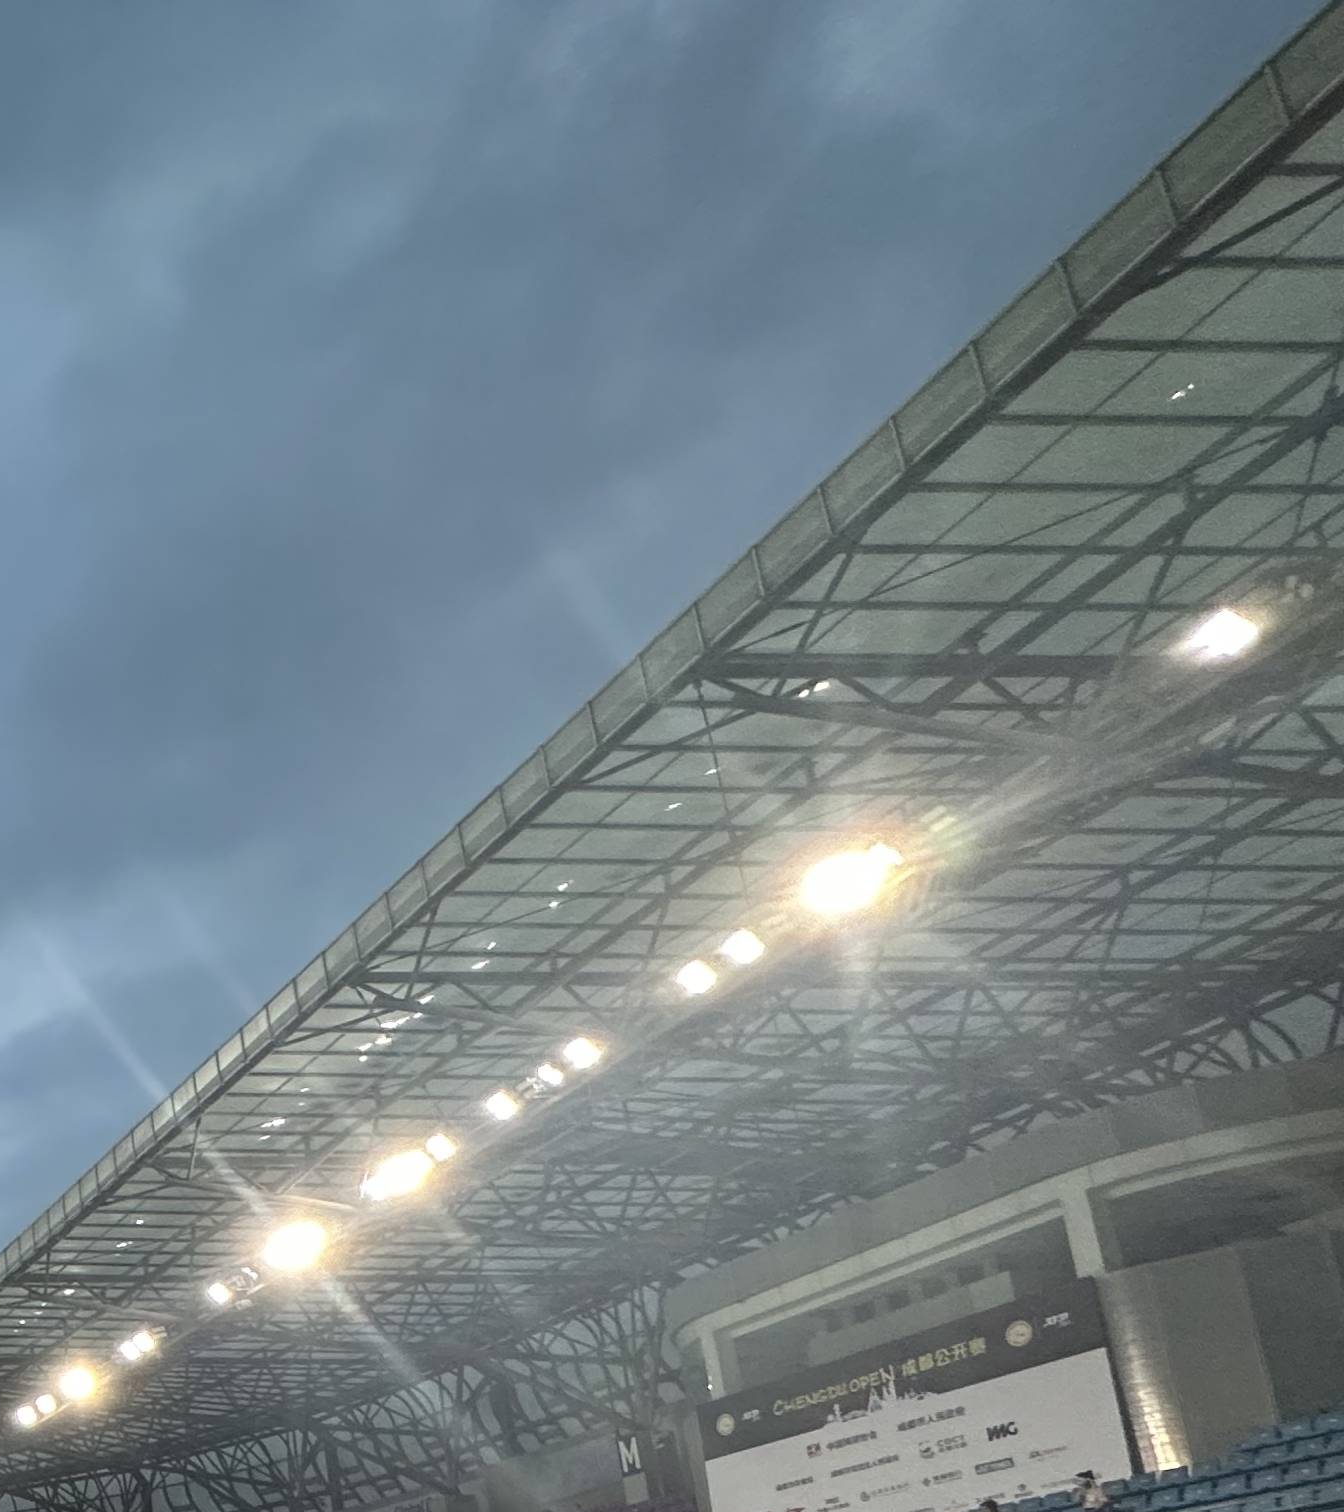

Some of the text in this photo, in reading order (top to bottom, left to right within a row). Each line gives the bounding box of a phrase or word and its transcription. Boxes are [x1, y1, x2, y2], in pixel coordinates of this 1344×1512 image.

[772, 1382, 848, 1416] CHENGDU
[848, 1364, 896, 1394] OPEN
[618, 1437, 641, 1473] M
